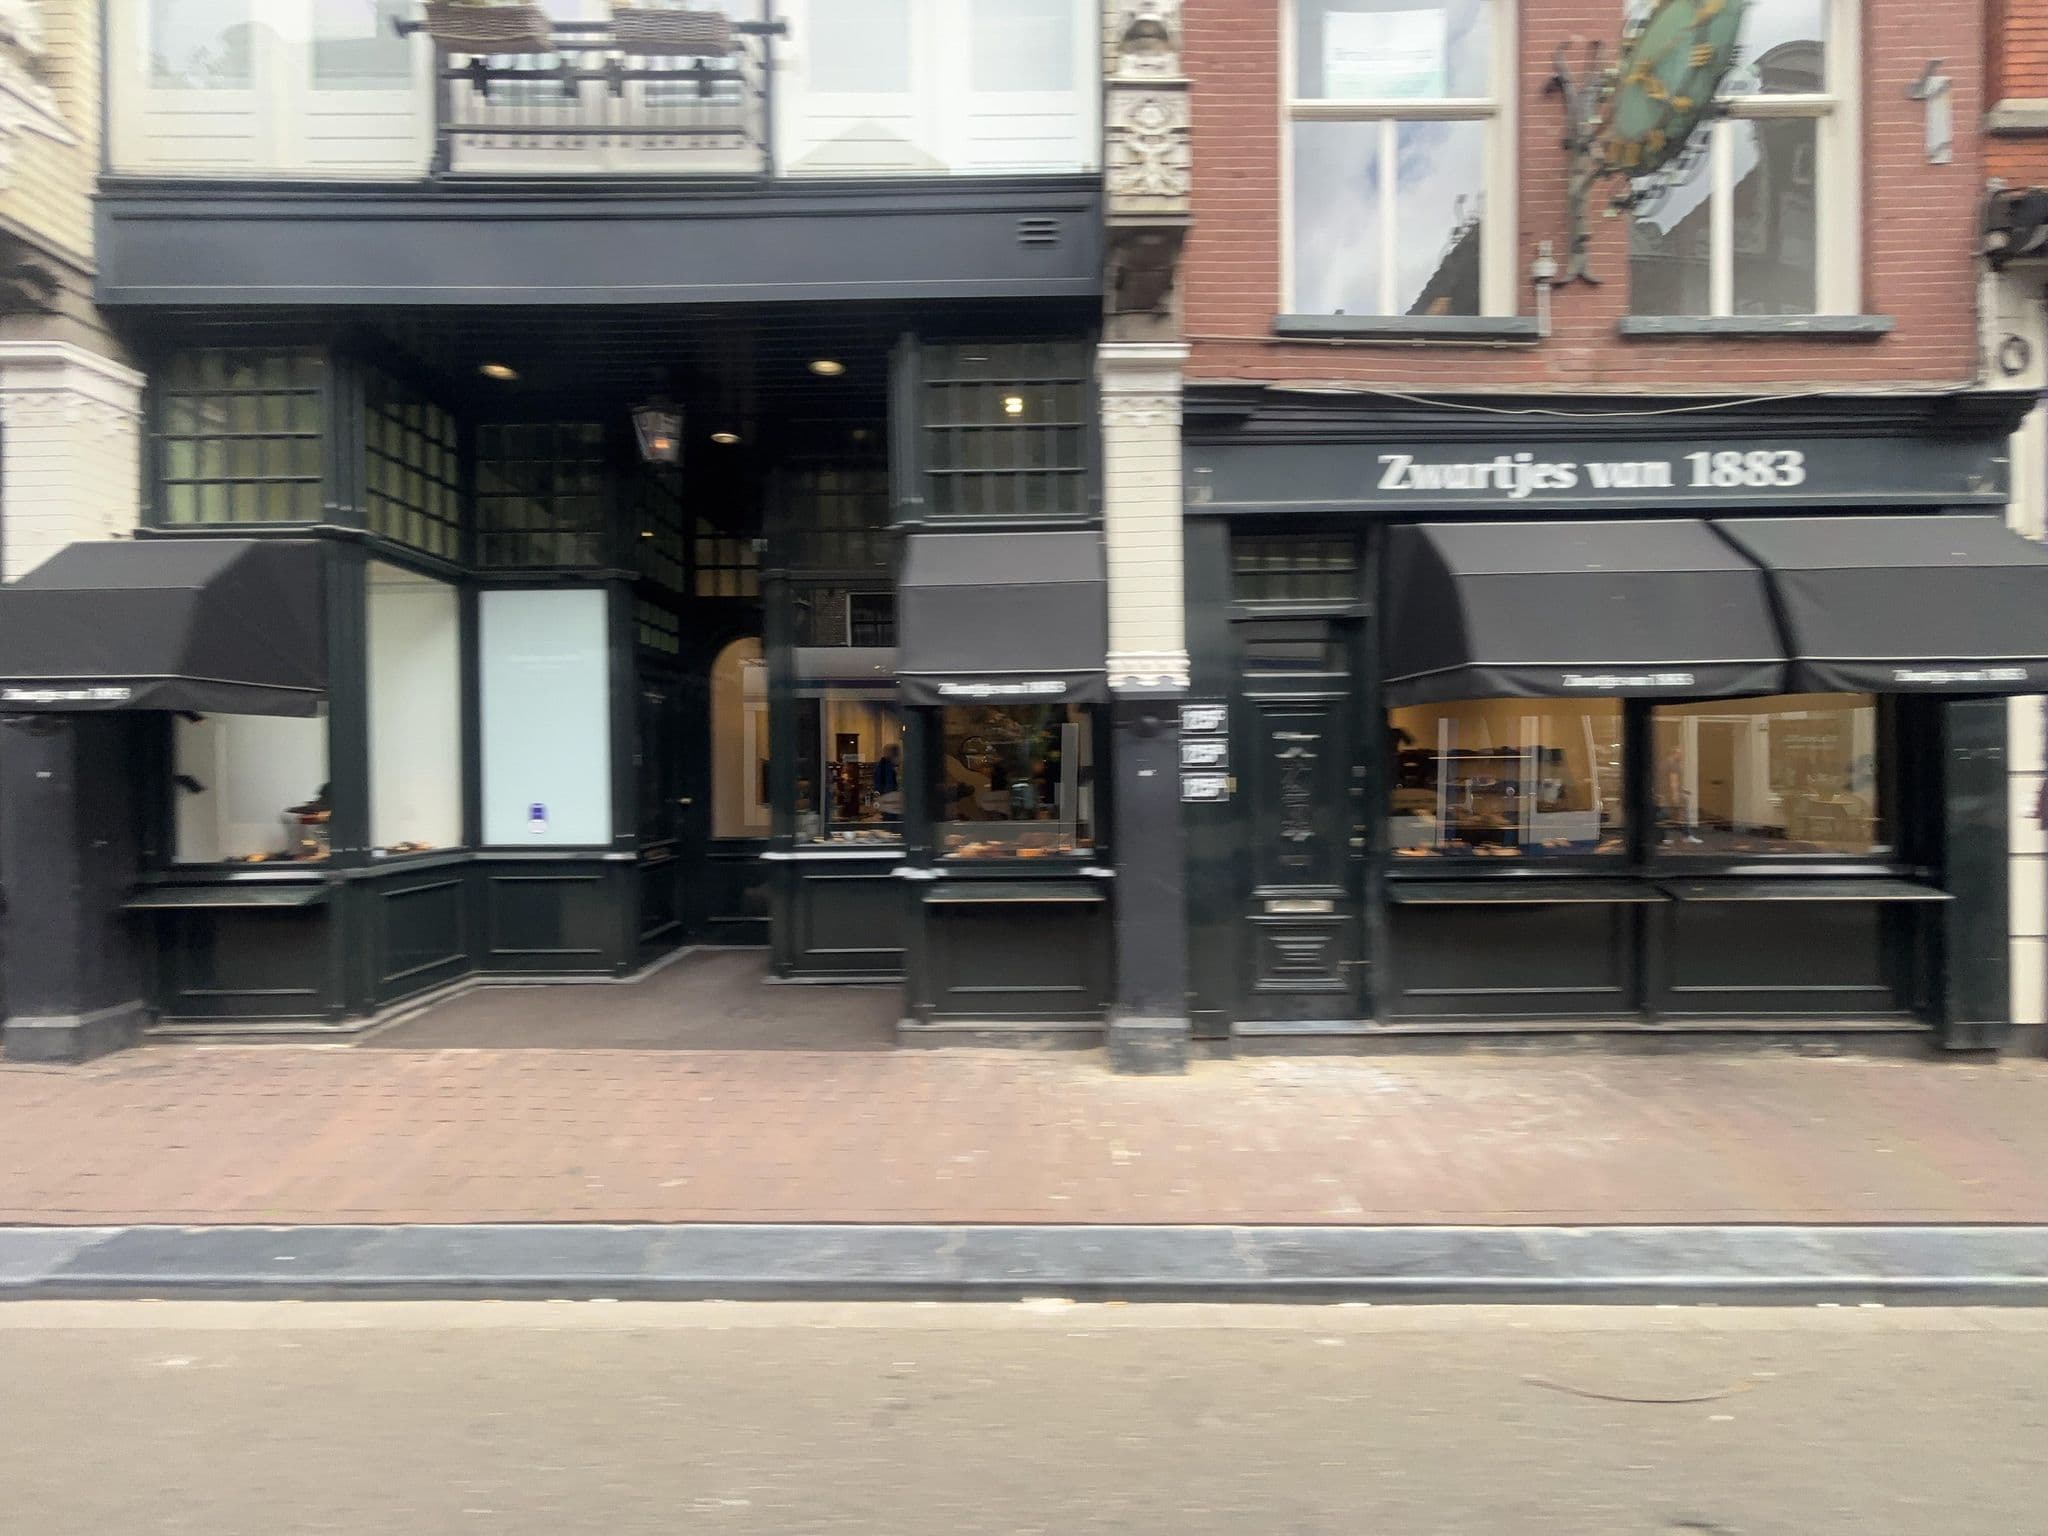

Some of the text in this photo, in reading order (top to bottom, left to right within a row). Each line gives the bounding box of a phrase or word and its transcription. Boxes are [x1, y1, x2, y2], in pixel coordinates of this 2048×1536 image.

[1377, 450, 1806, 498] Zwartjes van 1883
